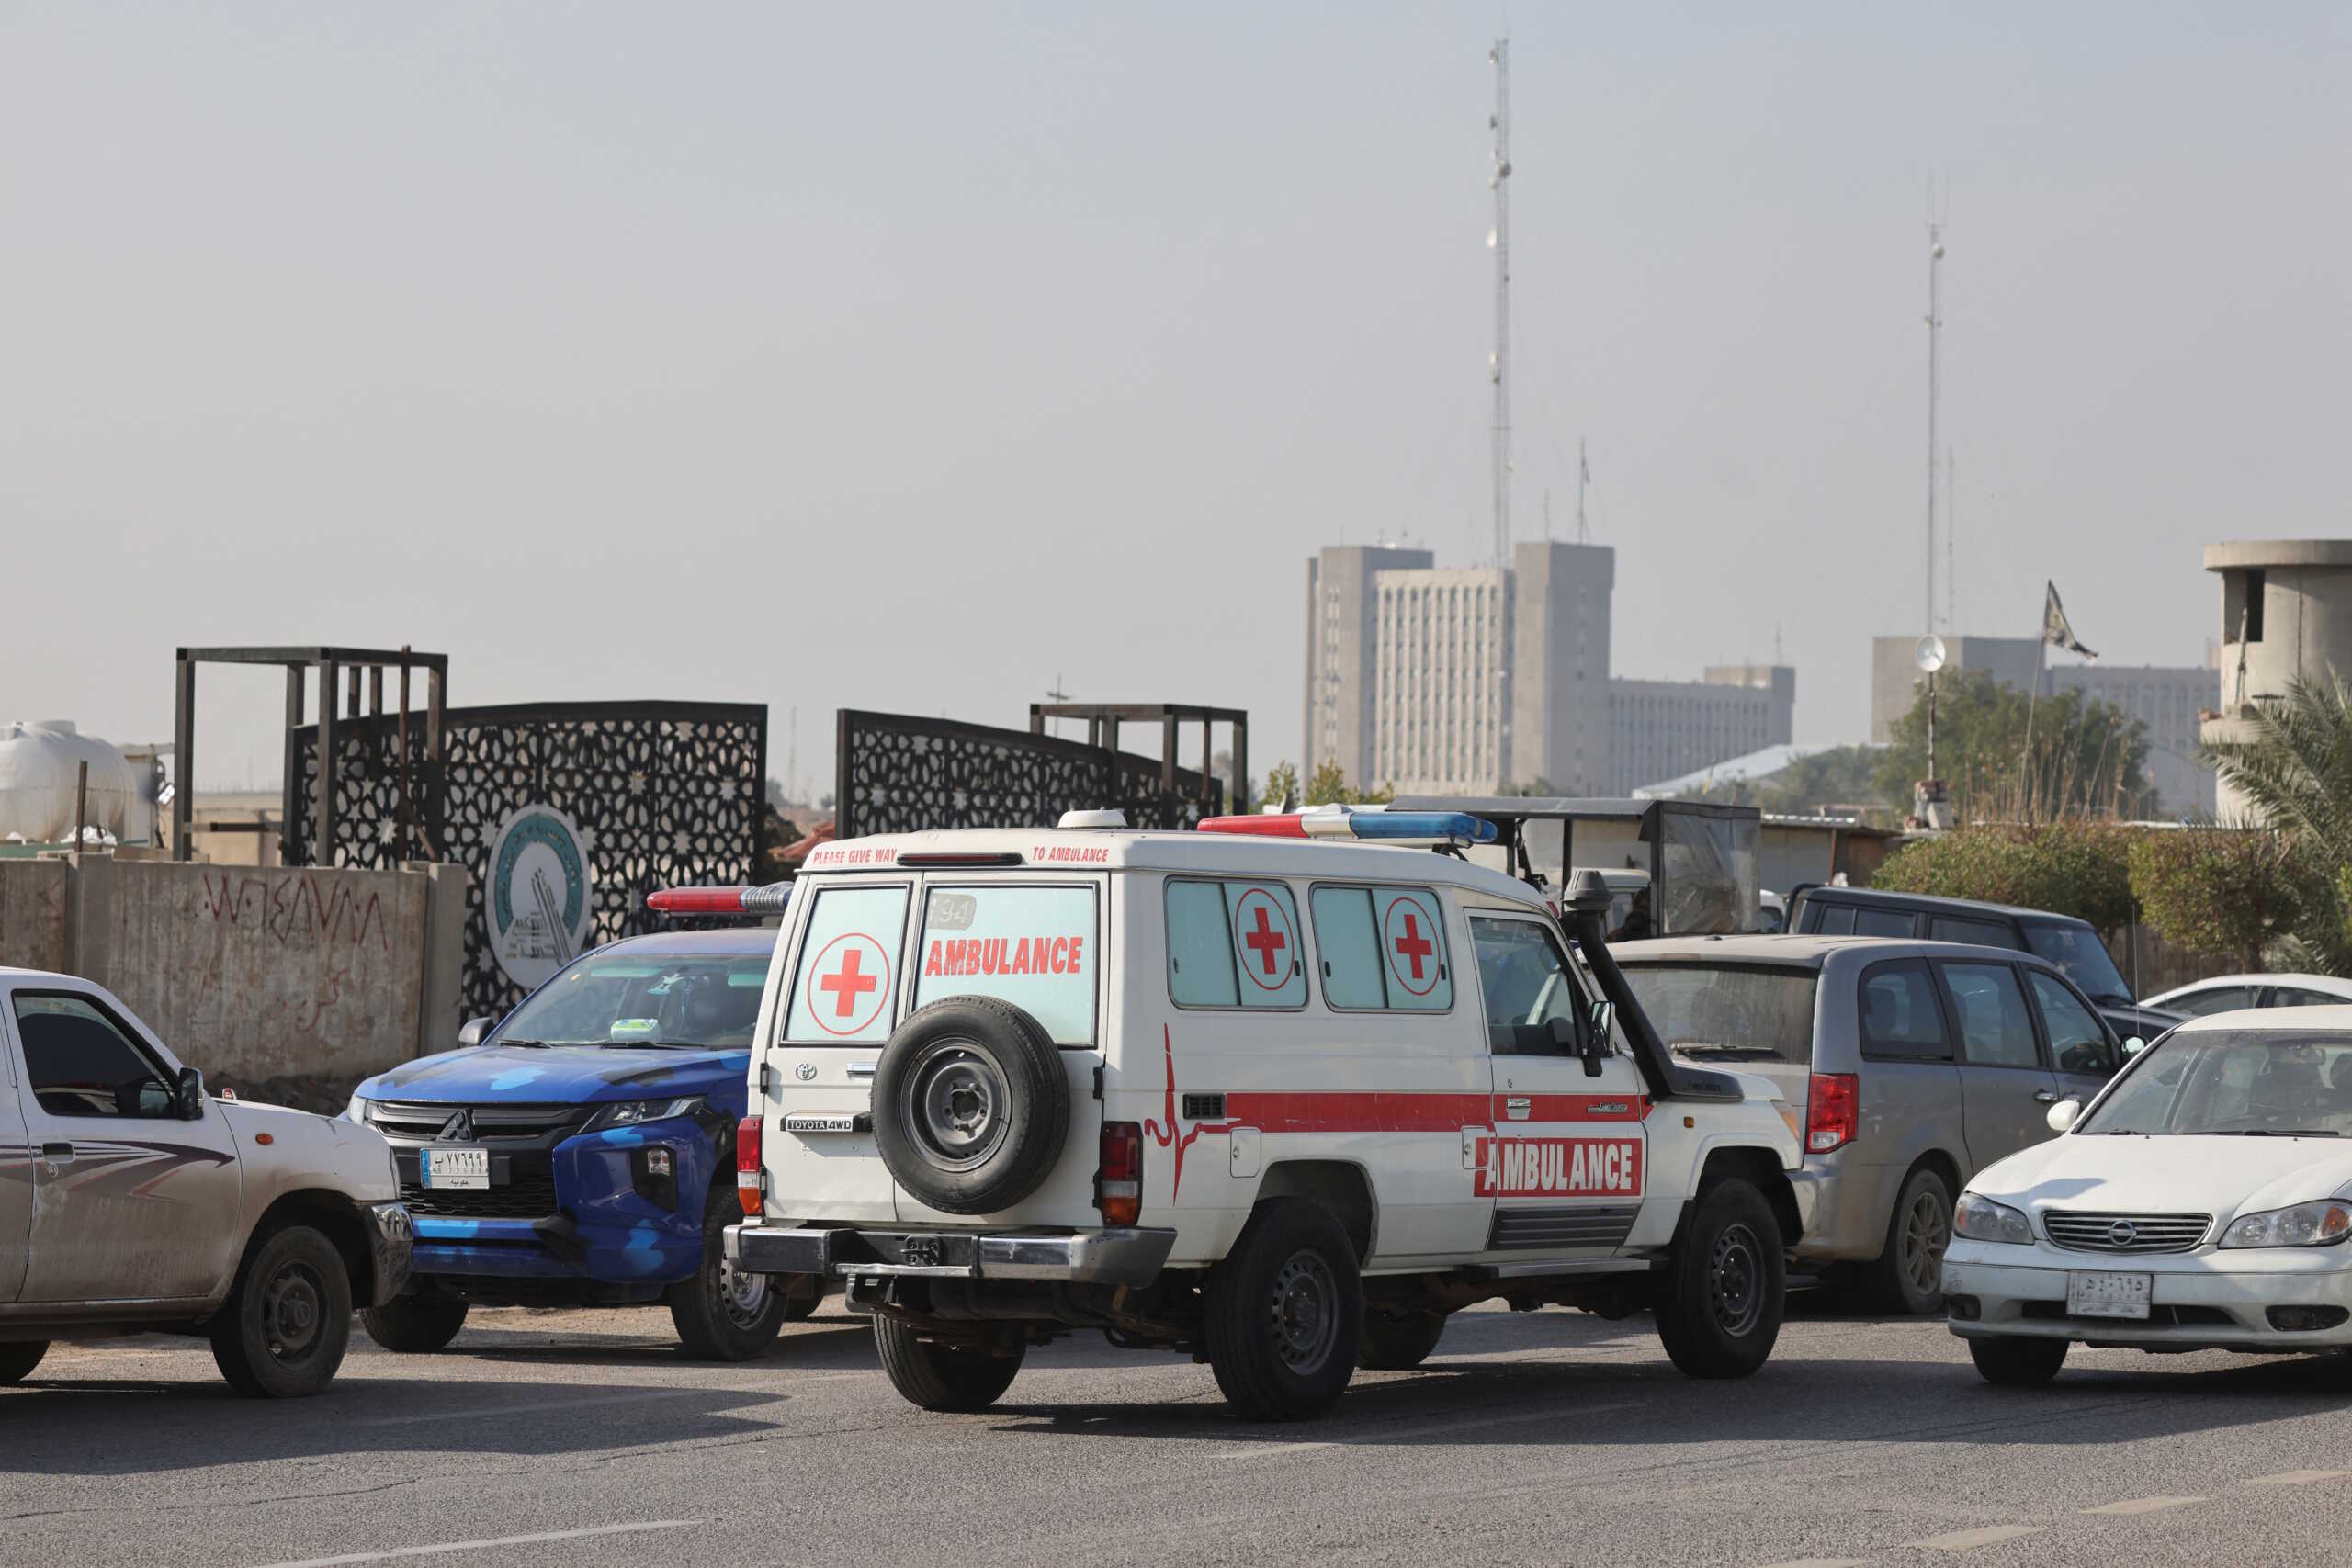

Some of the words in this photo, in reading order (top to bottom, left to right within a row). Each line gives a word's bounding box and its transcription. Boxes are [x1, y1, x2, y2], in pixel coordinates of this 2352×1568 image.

[813, 851, 846, 864] PLEASE
[848, 849, 872, 863] GIVE
[875, 849, 897, 862] WAY
[1033, 846, 1046, 860] TO
[1048, 847, 1109, 862] AMBULANCE
[924, 936, 1084, 976] AMBULANCE
[790, 1121, 825, 1129] TOYOTA
[828, 1120, 852, 1130] 4WD
[1484, 1142, 1633, 1191] AMBULANCE
